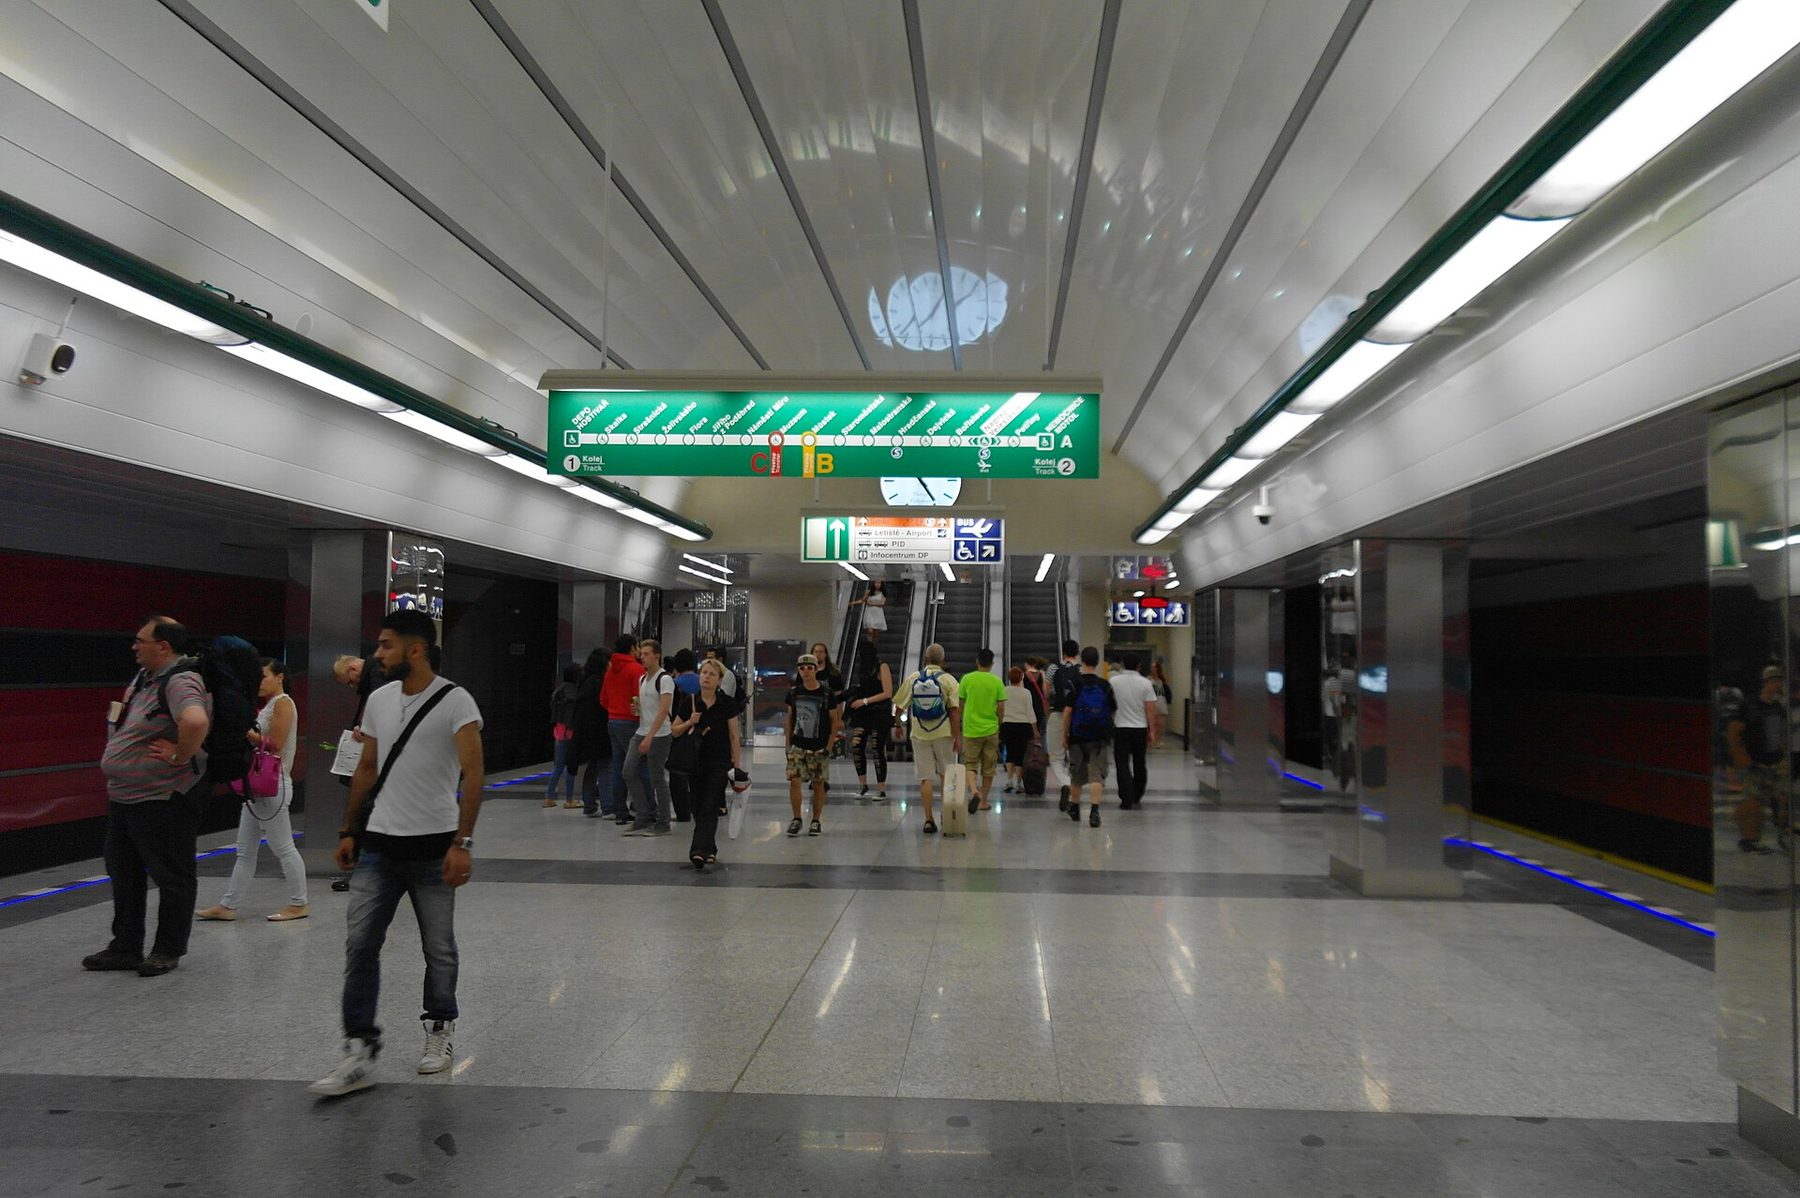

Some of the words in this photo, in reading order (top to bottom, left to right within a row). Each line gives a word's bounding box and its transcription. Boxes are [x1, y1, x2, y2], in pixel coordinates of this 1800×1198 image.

[571, 407, 591, 425] DEPO
[780, 408, 808, 435] Muzeum
[604, 413, 628, 434] Skalka
[689, 416, 709, 434] Flora
[1054, 412, 1080, 435] MOTOL
[1060, 434, 1073, 448] A
[568, 457, 574, 470] 1
[582, 455, 603, 464] Kolej
[751, 452, 768, 473] C
[817, 453, 834, 473] B
[1034, 458, 1056, 466] Kolej
[1062, 460, 1071, 473] 2
[1035, 467, 1056, 475] Track
[906, 529, 932, 538] Airport
[870, 551, 916, 559] Infocentrum
